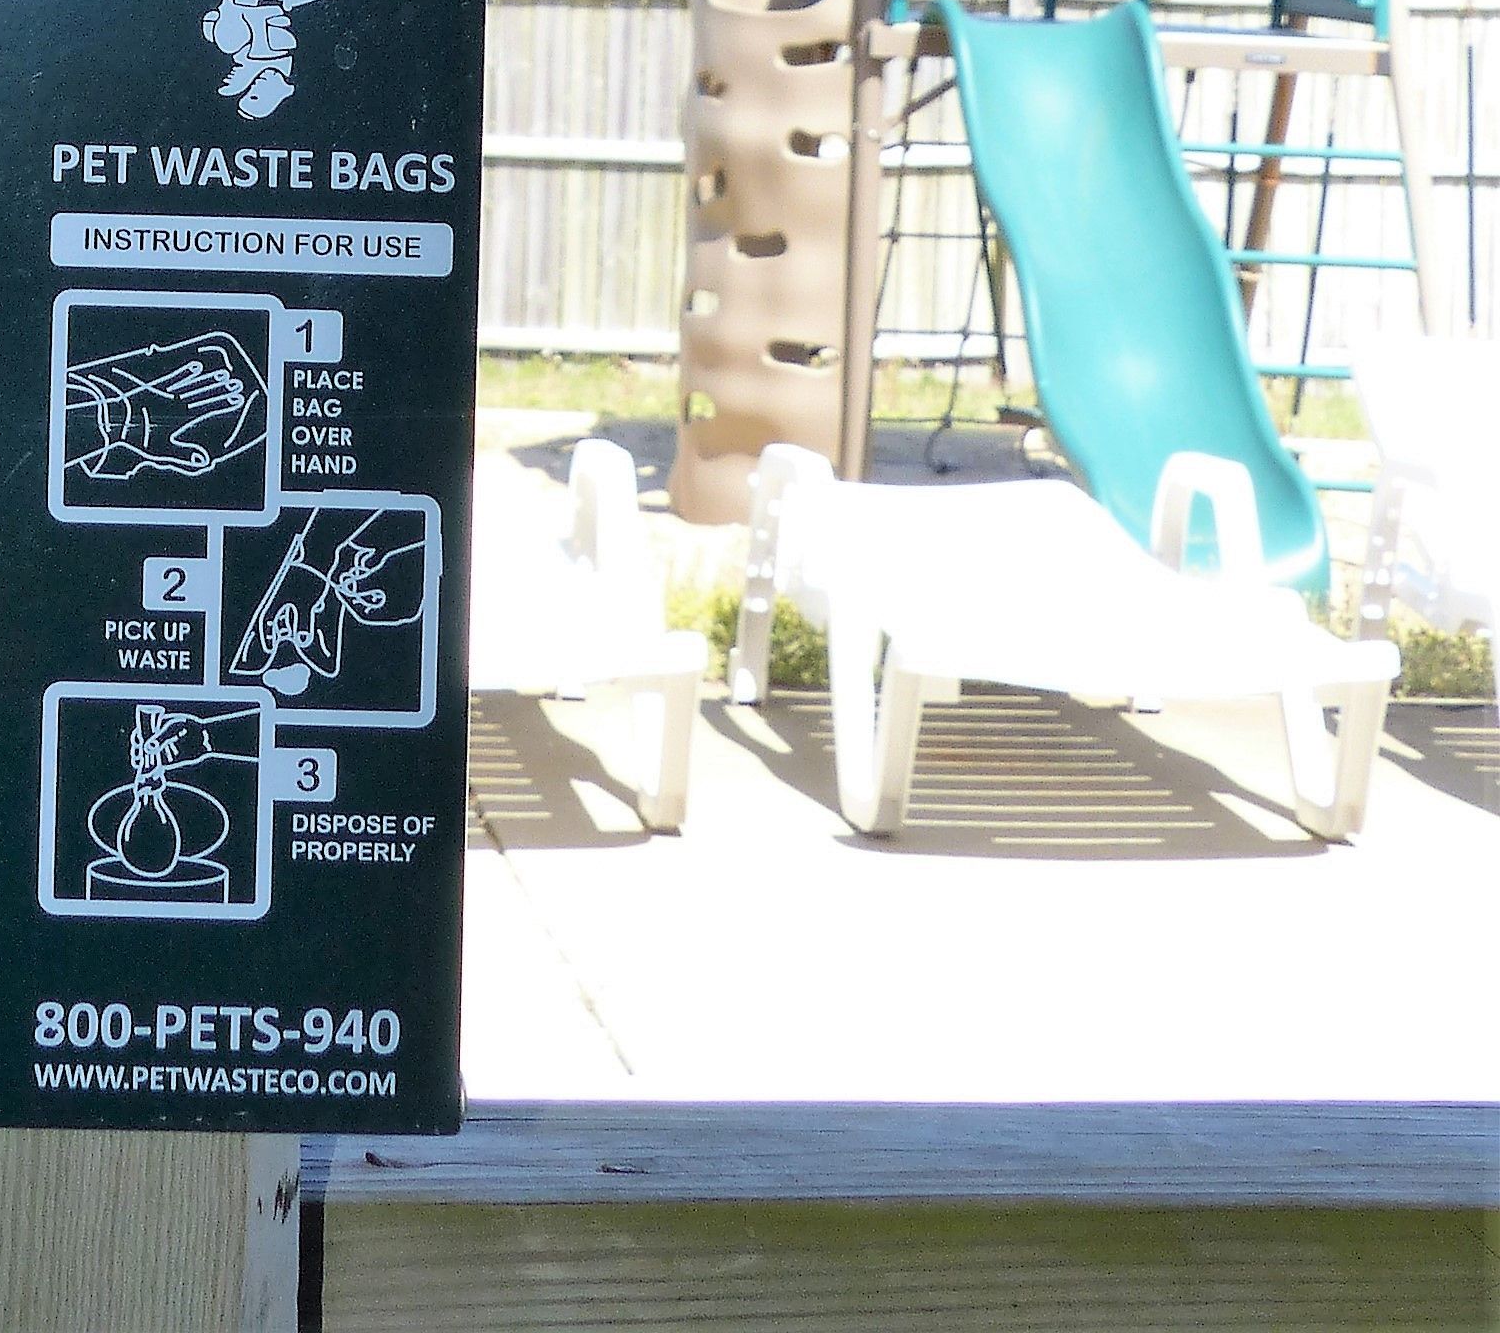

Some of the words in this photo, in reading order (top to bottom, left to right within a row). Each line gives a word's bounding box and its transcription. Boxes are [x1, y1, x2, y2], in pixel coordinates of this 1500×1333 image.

[53, 144, 137, 183] PET
[151, 147, 313, 188] WASTE
[331, 152, 455, 192] BAGS
[85, 228, 283, 254] INSTRUCTION
[296, 234, 353, 256] FOR
[364, 236, 420, 258] USE
[296, 319, 312, 352] 1
[294, 370, 363, 389] PLACE
[293, 398, 341, 417] BAG
[292, 426, 352, 446] OVER
[292, 454, 356, 474] HAND
[163, 568, 185, 601] 2
[106, 621, 156, 640] PICK
[164, 622, 190, 641] UP
[119, 649, 190, 669] WASTE
[297, 758, 319, 791] 3
[293, 814, 396, 834] DISPOSE
[404, 816, 435, 834] OF
[292, 841, 415, 862] PROPERLY
[35, 1002, 400, 1054] 800-PETS-940
[34, 1064, 395, 1095] WWW.PETWASTECO.COM
